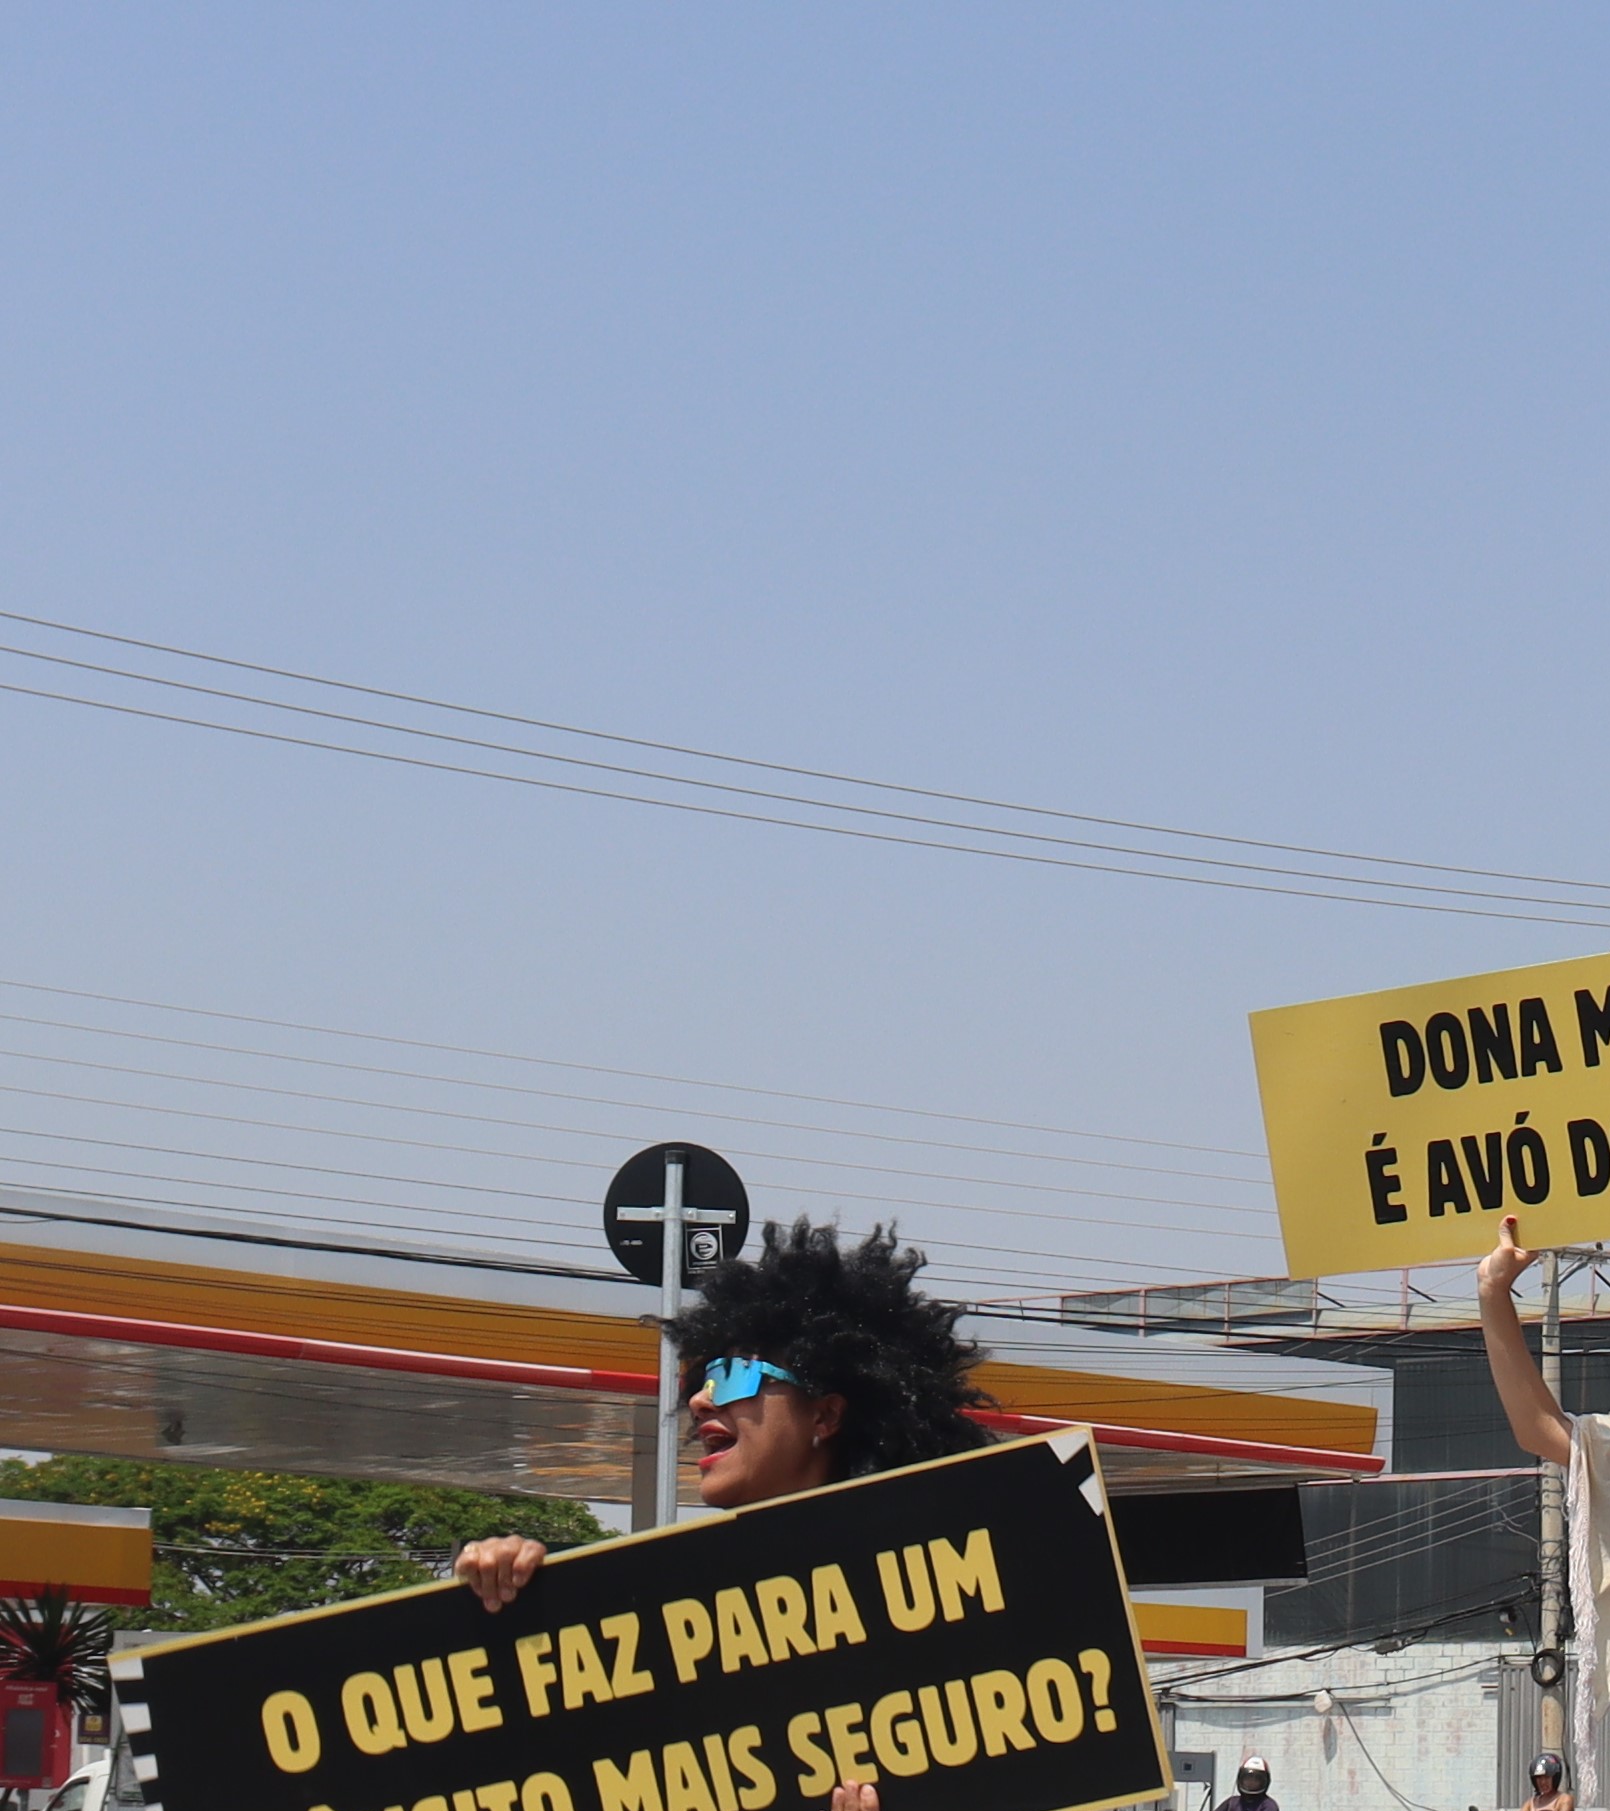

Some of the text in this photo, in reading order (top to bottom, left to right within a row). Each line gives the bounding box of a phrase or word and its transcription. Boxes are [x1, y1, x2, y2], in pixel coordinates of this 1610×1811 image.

[1379, 996, 1564, 1099] DONA
[1364, 1131, 1409, 1226] É
[1427, 1109, 1551, 1219] AVÓ
[262, 1527, 1006, 1773] O QUE FAZ PARA UM
[787, 1647, 1118, 1798] SEGURO?
